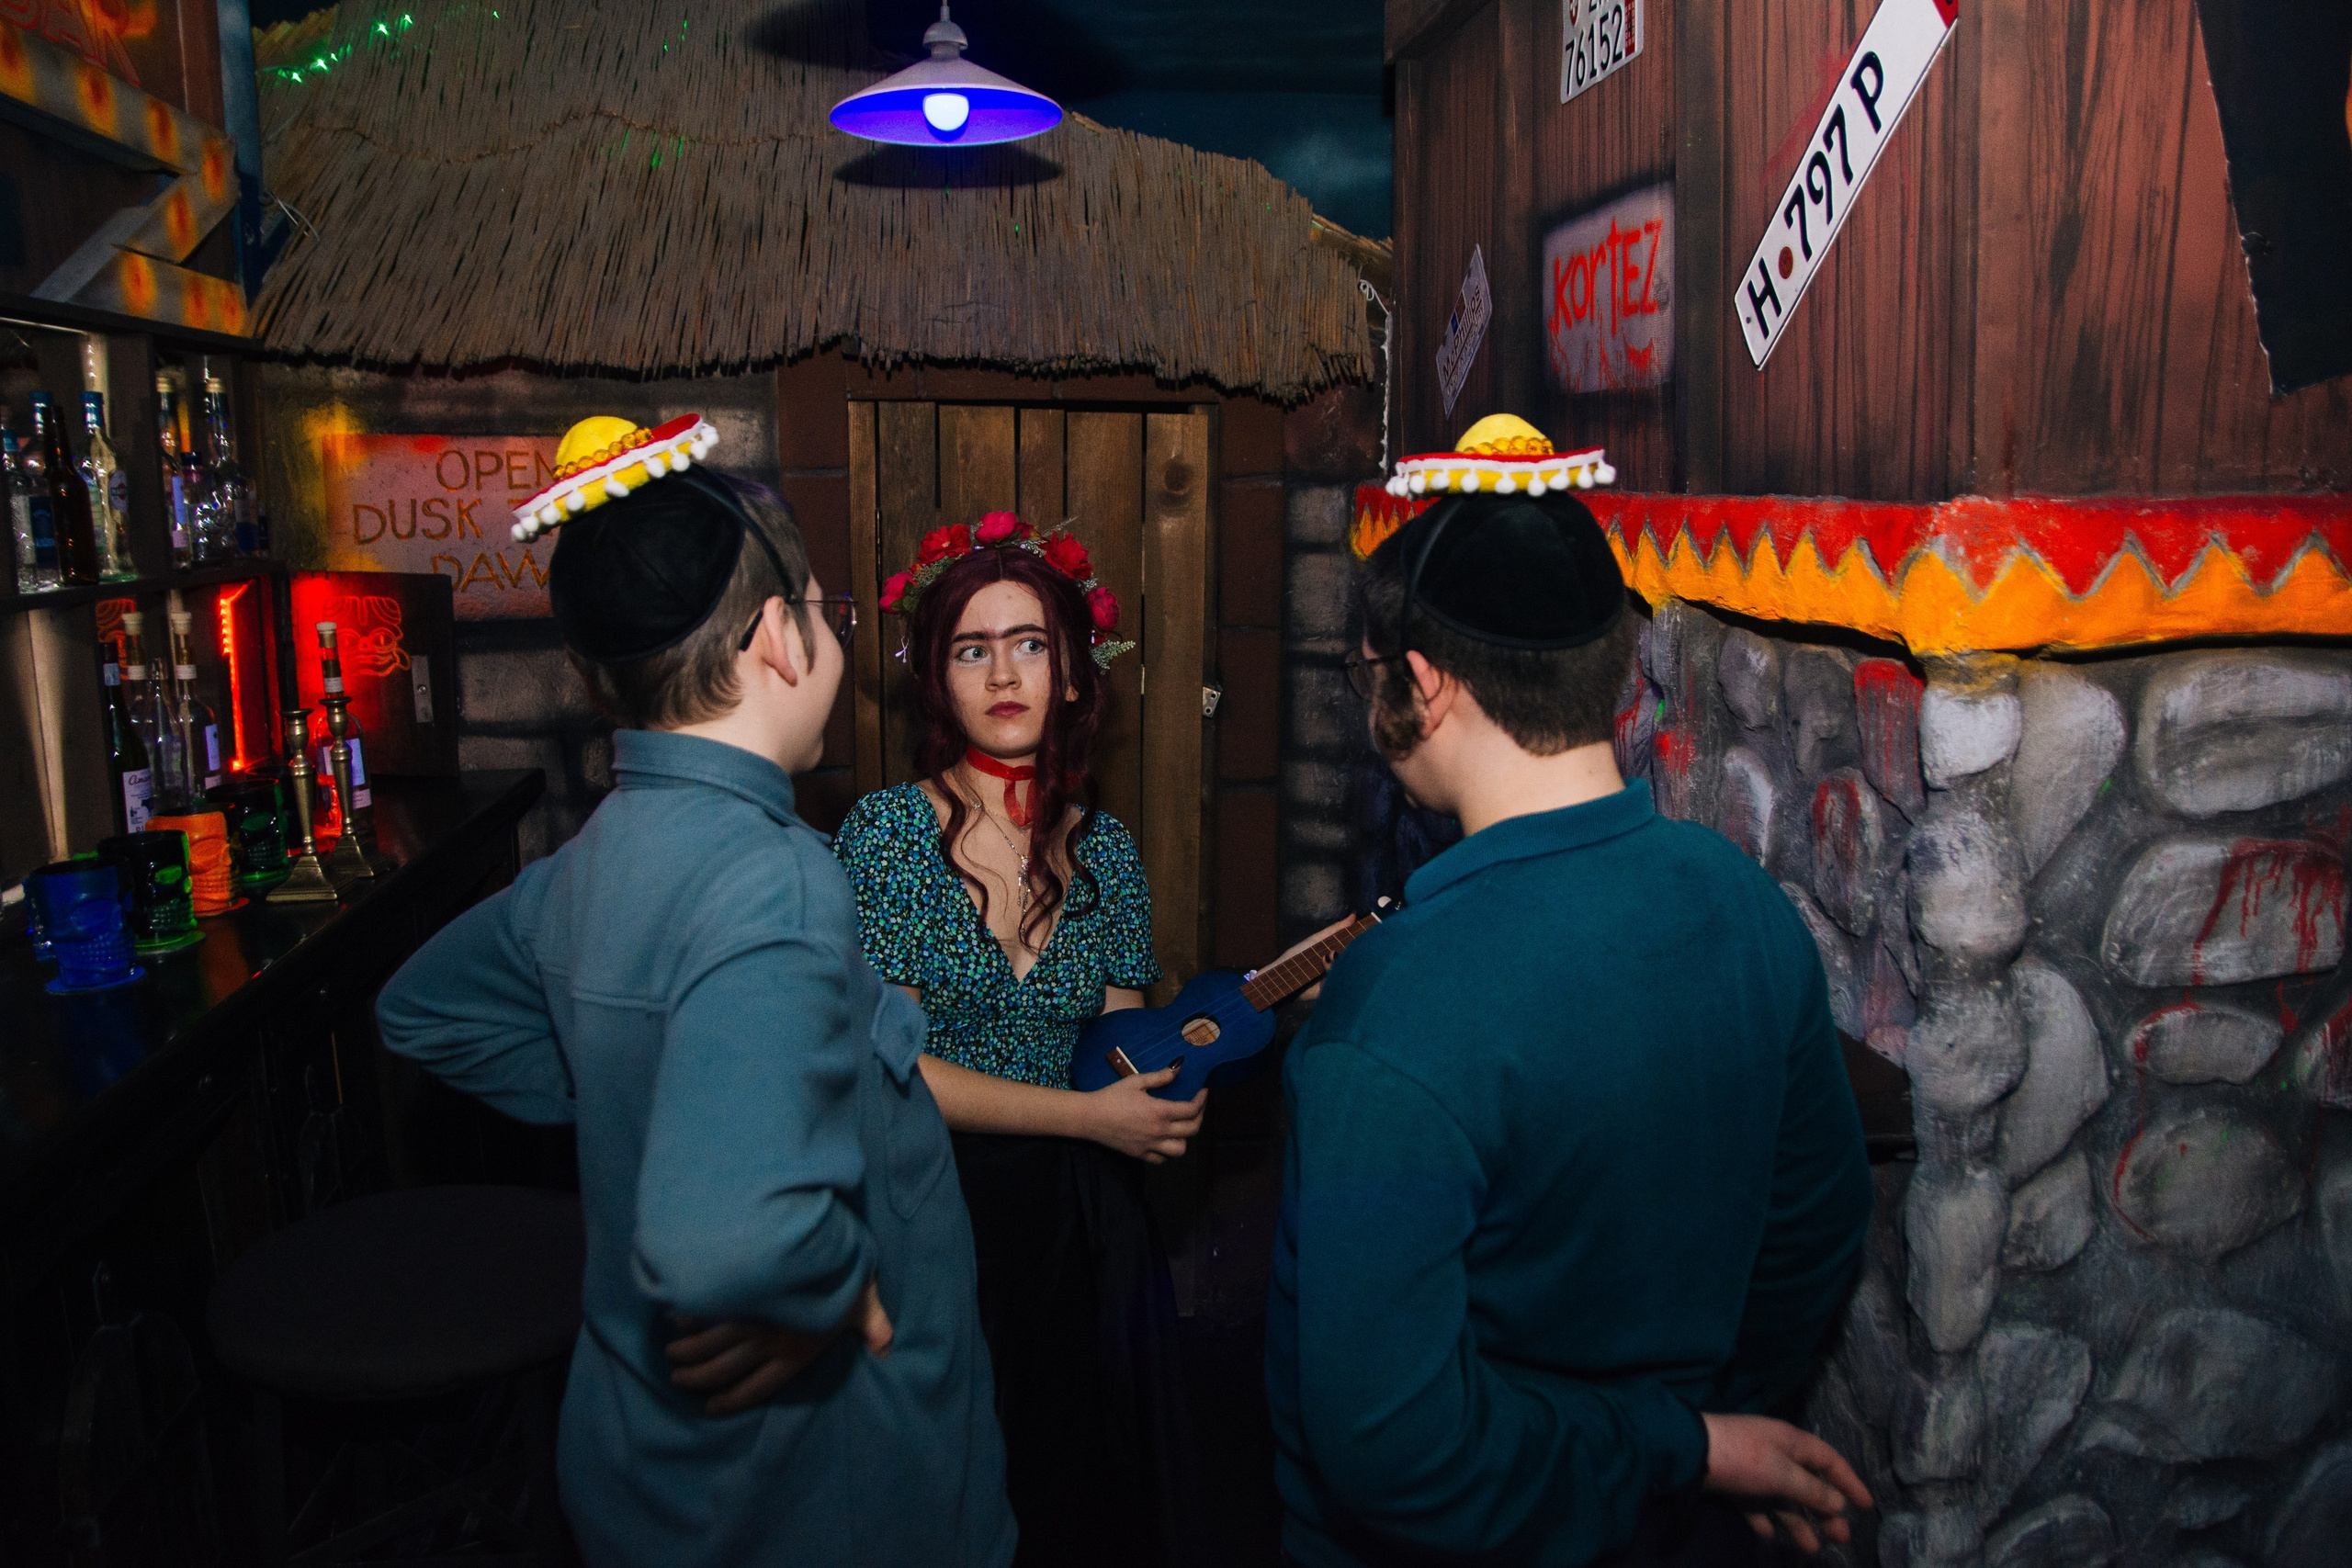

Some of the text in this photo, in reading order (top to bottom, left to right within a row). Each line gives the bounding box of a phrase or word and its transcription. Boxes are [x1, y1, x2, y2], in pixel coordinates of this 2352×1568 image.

[1565, 4, 1623, 96] 76152
[1747, 51, 1884, 340] H 797 P
[1442, 285, 1482, 382] McPhillips
[353, 497, 483, 546] DUSK
[431, 549, 552, 592] DAW
